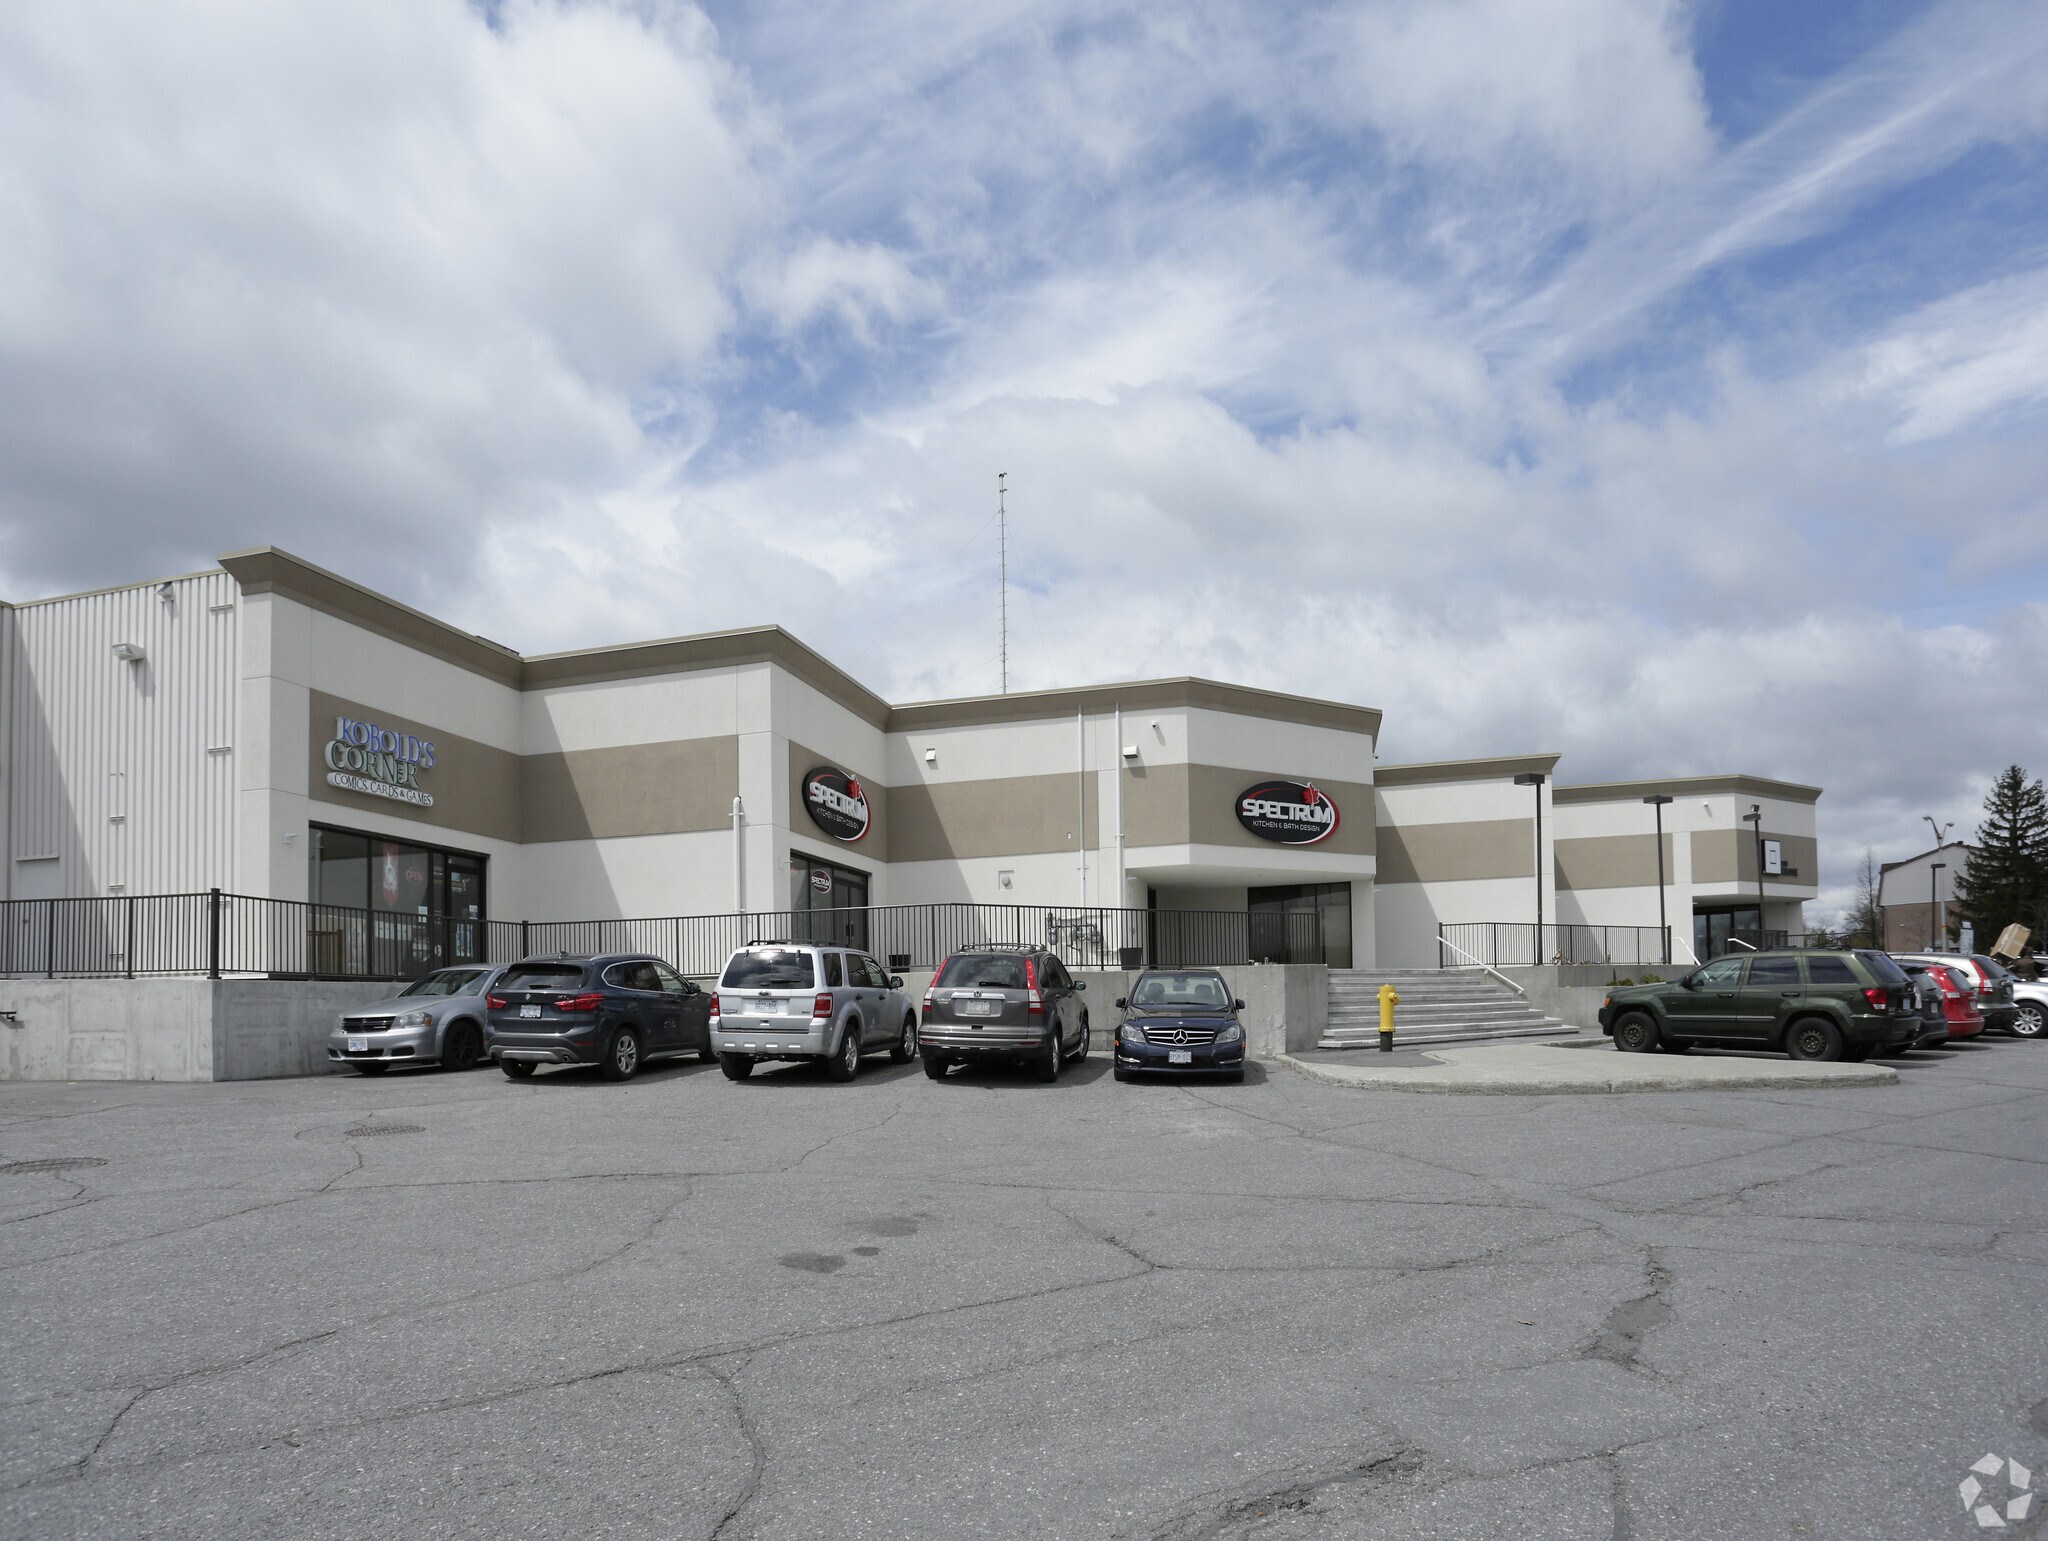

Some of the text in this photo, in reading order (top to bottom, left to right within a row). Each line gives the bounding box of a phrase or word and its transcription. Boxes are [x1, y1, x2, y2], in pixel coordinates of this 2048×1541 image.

[337, 717, 436, 769] KOBOLD'S
[328, 740, 420, 788] CORNER
[370, 781, 399, 798] CARDS
[399, 789, 406, 798] &
[406, 789, 432, 806] GAMES
[810, 781, 867, 823] SPECTRUM
[1242, 799, 1331, 824] SPECTRUM
[1252, 820, 1278, 829] KITCHEN
[1300, 824, 1321, 832] DESIGN
[405, 870, 424, 881] OPEN
